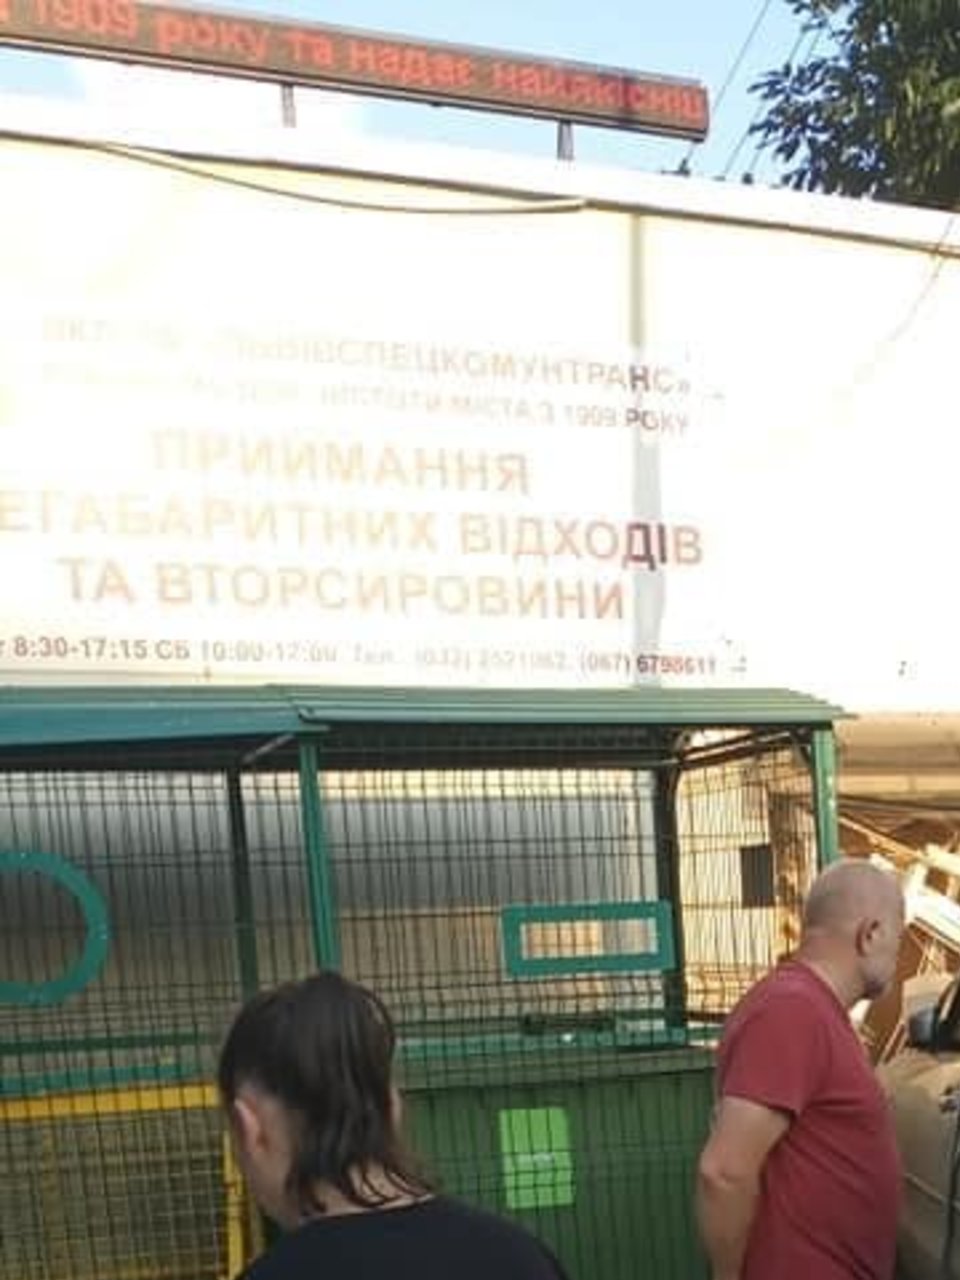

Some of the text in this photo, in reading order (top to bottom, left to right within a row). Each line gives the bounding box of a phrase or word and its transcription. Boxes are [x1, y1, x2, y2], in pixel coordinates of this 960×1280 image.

[157, 12, 268, 62] року
[282, 27, 333, 68] та
[349, 38, 472, 88] надає
[625, 407, 689, 437] РОКУ
[459, 512, 704, 572] ВІДХОДІВ
[56, 555, 625, 621] ТА ВТОРСИРОВИНИ
[13, 635, 147, 660] 8:30-17:15
[154, 639, 190, 661] СБ
